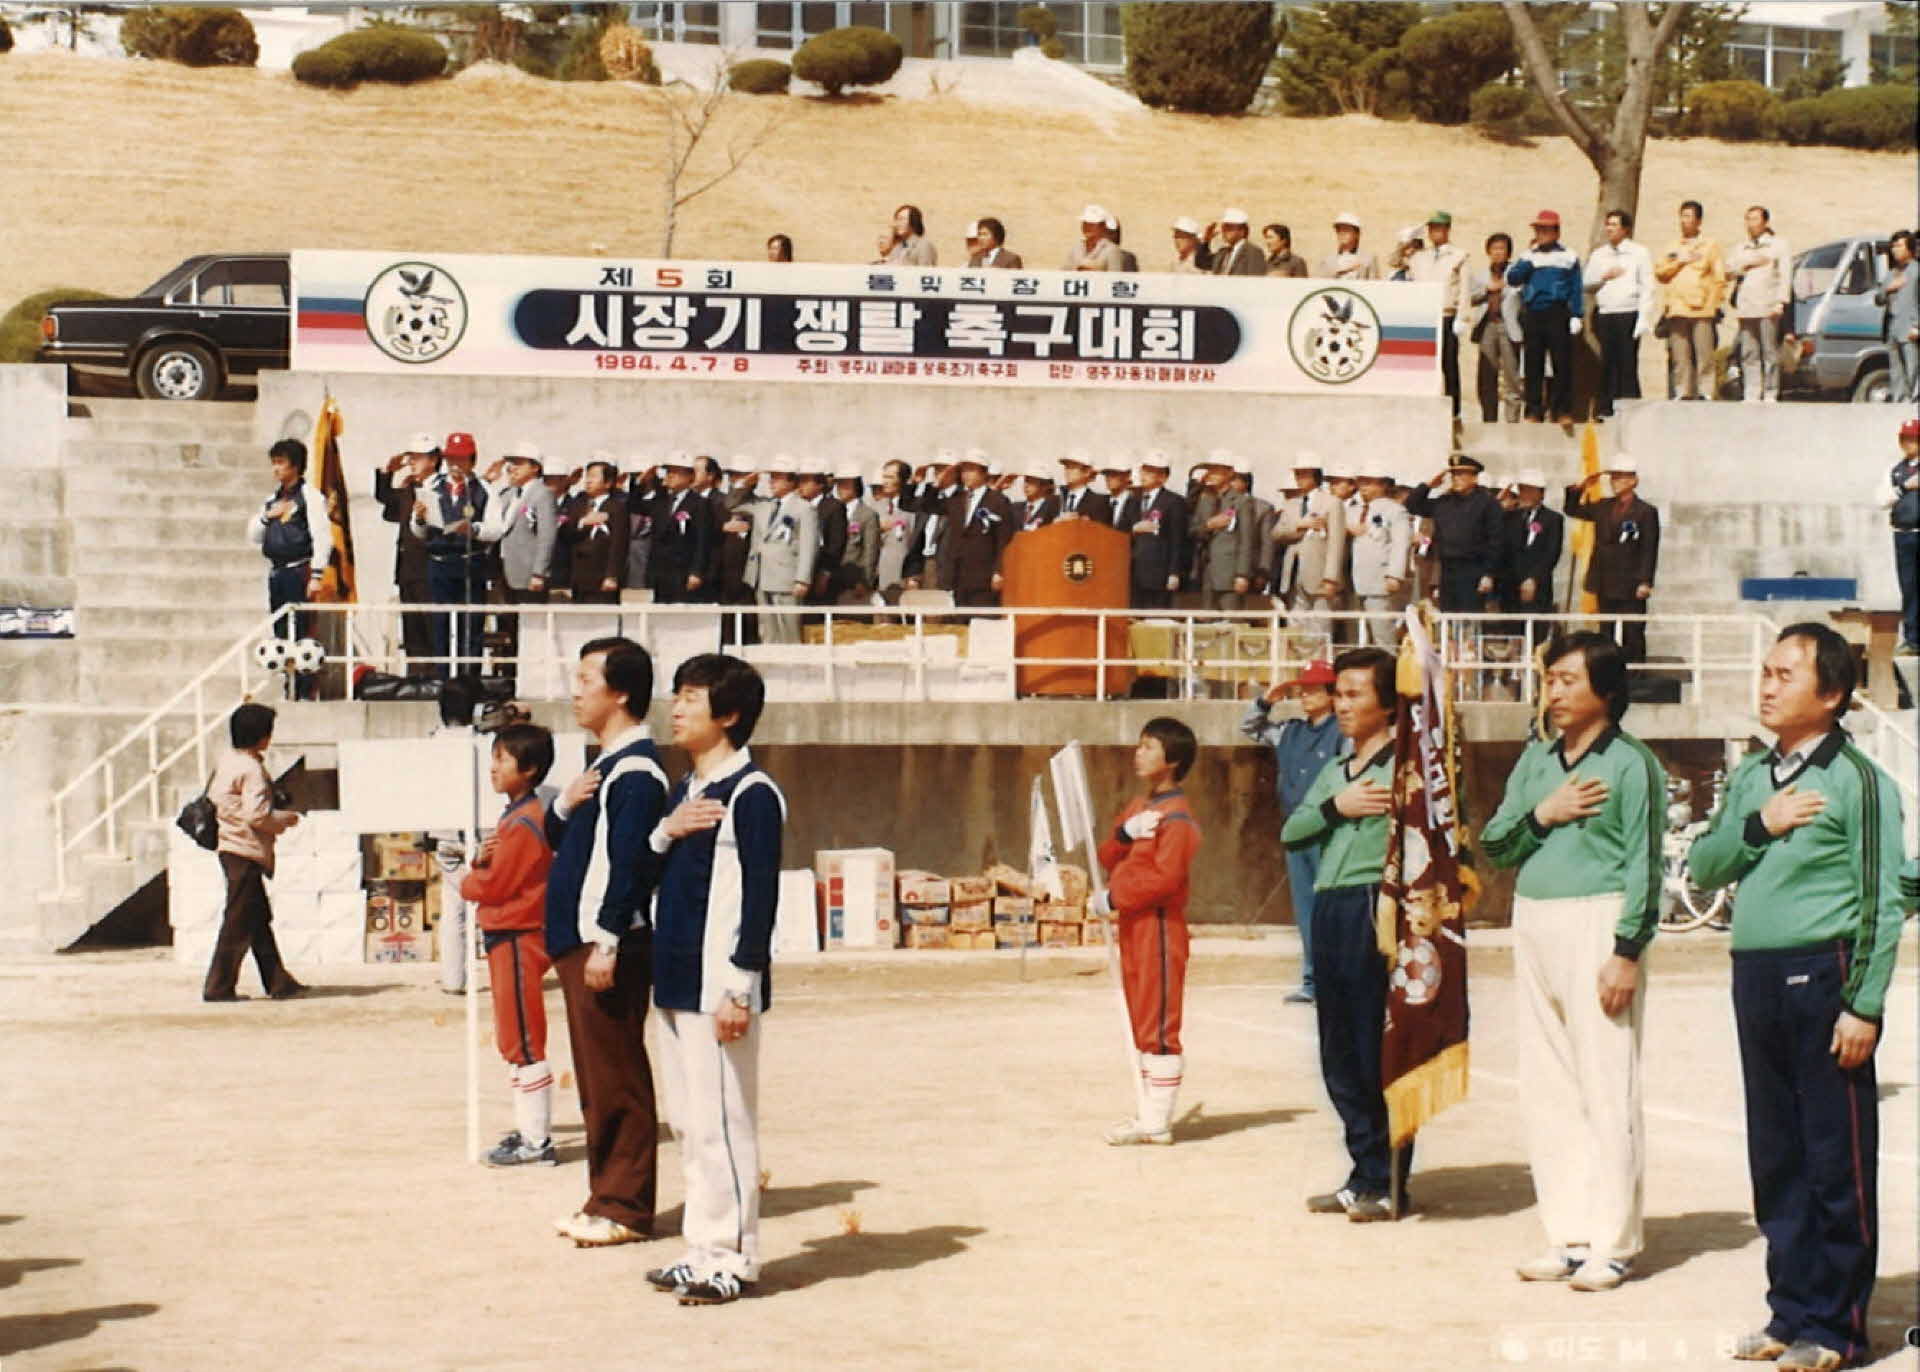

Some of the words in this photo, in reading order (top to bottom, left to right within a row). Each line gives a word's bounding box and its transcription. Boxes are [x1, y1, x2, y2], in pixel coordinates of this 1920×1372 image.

[565, 294, 762, 351] 시장기
[794, 299, 922, 354] 쟁탈
[945, 303, 1196, 361] 축구대회
